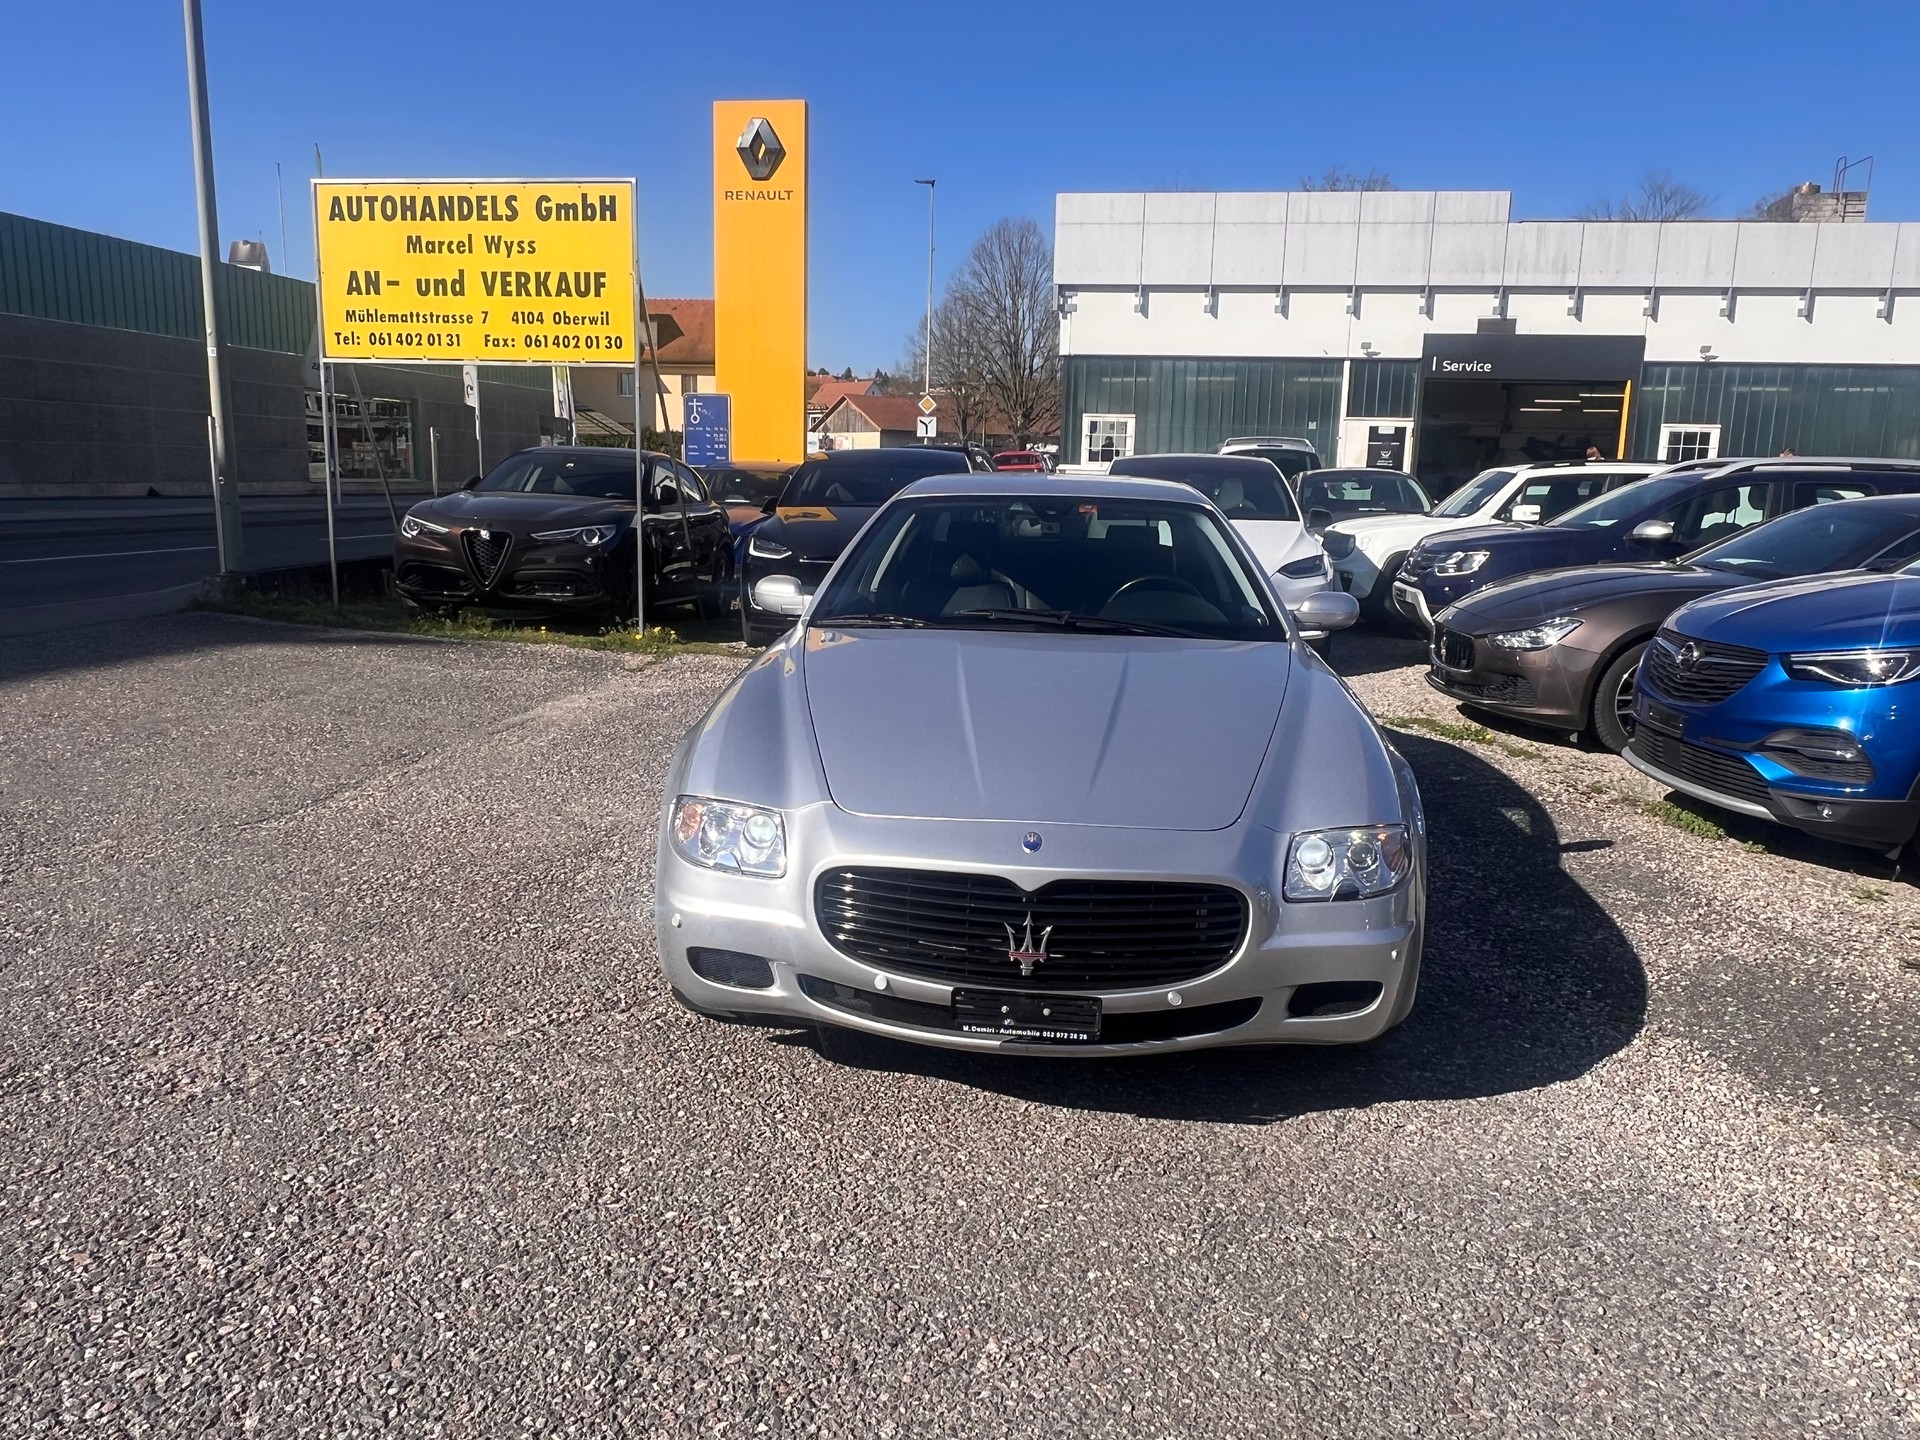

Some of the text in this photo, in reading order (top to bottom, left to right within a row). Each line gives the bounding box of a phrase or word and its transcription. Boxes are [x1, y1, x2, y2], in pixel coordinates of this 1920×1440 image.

[724, 190, 794, 201] RENAULT
[328, 192, 618, 222] AUTOHANDELS GmbH
[406, 233, 537, 258] Marcel Wyss
[416, 269, 465, 297] und
[480, 271, 607, 298] VERKAUF
[345, 308, 610, 326] Mühlemattstrasse 7 4104 Oberwil
[334, 330, 361, 346] Tel:
[484, 333, 516, 348] Fax:
[1442, 360, 1492, 372] Service
